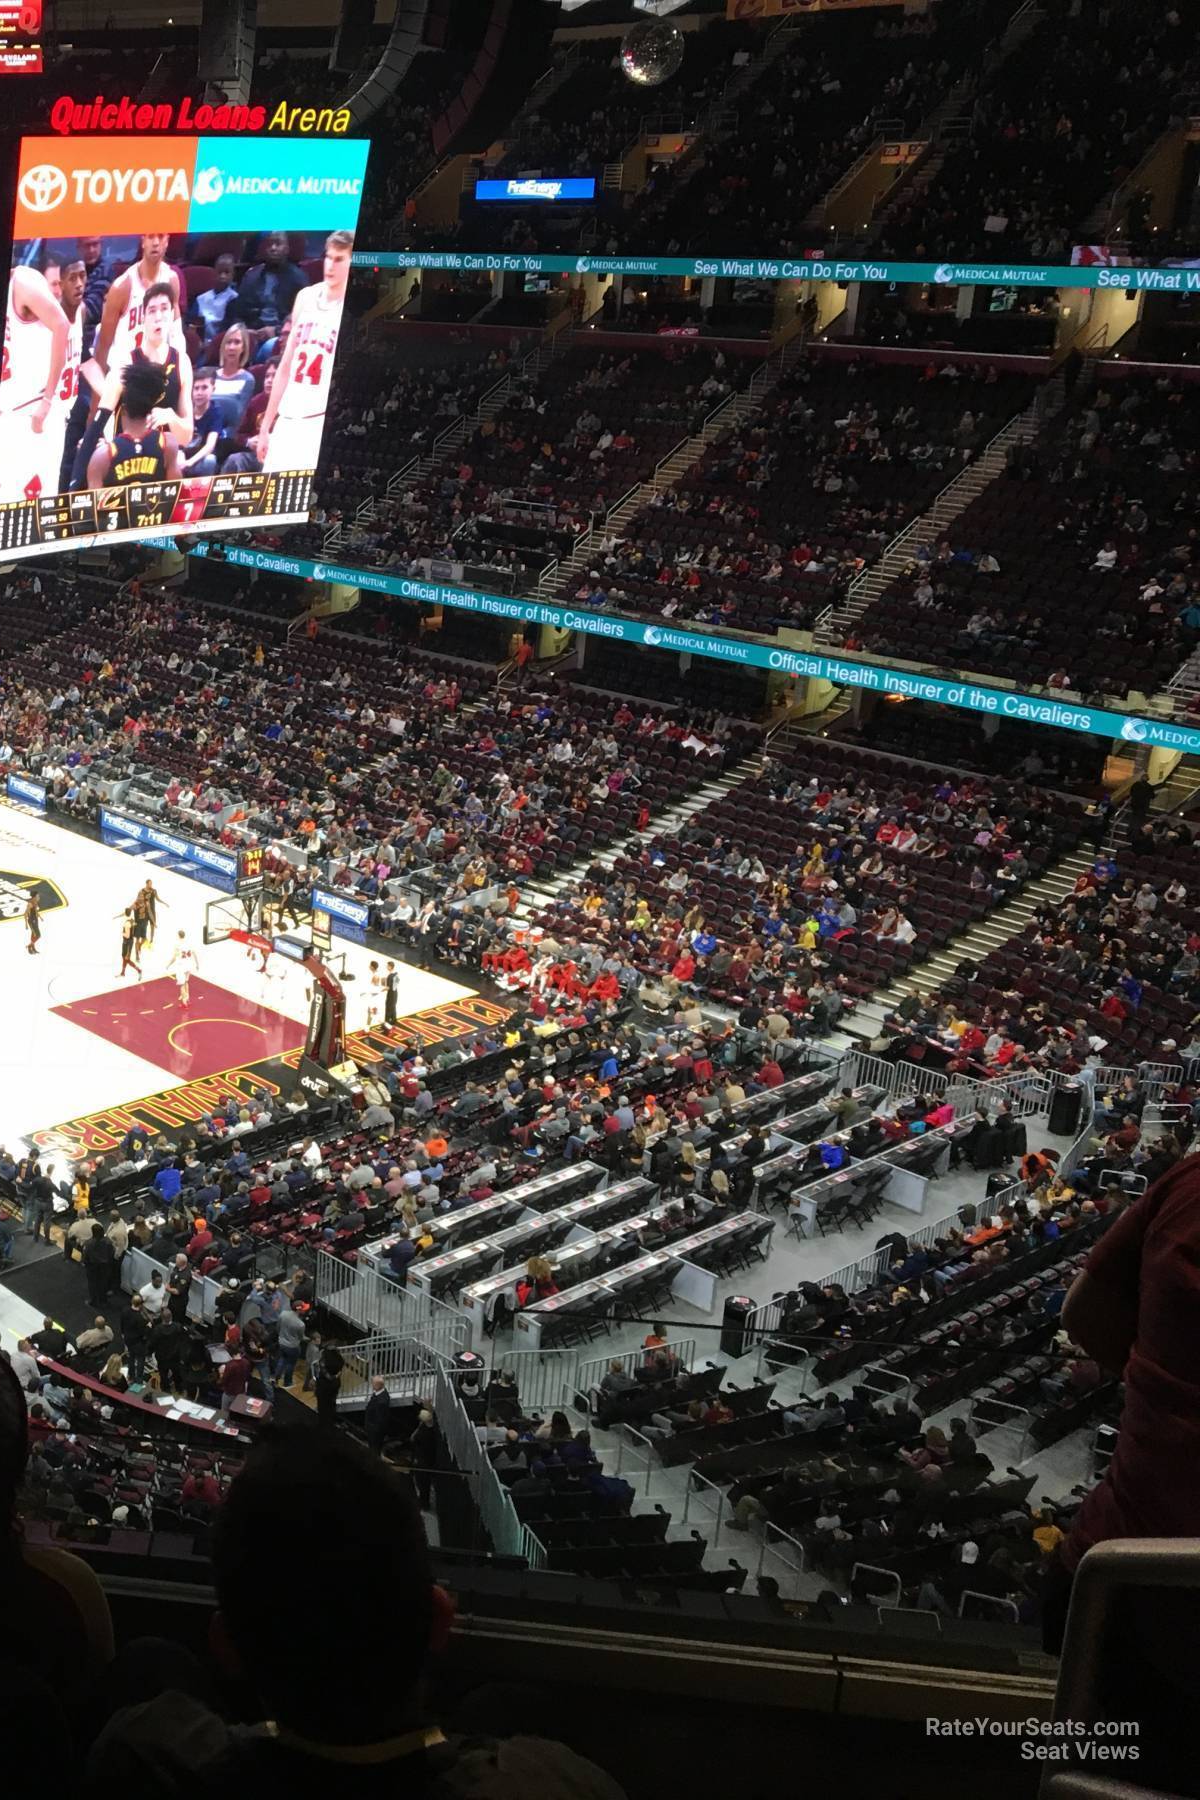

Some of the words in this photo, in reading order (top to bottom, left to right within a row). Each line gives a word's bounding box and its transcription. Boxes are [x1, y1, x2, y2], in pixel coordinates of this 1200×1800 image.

[51, 96, 171, 135] Quicken
[177, 98, 266, 131] Loans
[268, 101, 351, 132] Arena
[72, 169, 189, 204] TOYOTA
[225, 177, 293, 195] MEDICAL
[297, 177, 361, 195] MUTUAL
[507, 179, 562, 196] FirstEnergy
[352, 255, 379, 264] UTUAL
[399, 254, 417, 267] See
[418, 254, 443, 267] What
[445, 255, 460, 267] We
[463, 256, 484, 268] Can
[486, 256, 501, 269] Do
[504, 257, 520, 269] For
[522, 257, 542, 270] You
[591, 261, 623, 270] MEDICAL
[626, 261, 657, 270] MUTUAL
[694, 260, 719, 274] See
[722, 261, 754, 275] What
[758, 262, 779, 276] We
[782, 262, 808, 277] Can
[812, 263, 831, 277] Do
[835, 264, 859, 279] For
[862, 265, 887, 279] You
[955, 269, 1000, 280] MEDICAL
[1002, 270, 1047, 281] MUTUAL
[1097, 270, 1130, 286] See
[1136, 271, 1180, 288] What
[1186, 273, 1200, 289] W
[293, 351, 323, 386] 24
[114, 456, 158, 479] SEXTON
[107, 512, 118, 530] 3
[137, 513, 162, 526] 7:11
[184, 503, 194, 522] 7
[229, 550, 239, 563] of
[240, 551, 255, 565] the
[257, 553, 299, 574] Cavaliers
[327, 569, 359, 584] MEDICAL
[360, 575, 387, 588] MUTUAL
[401, 582, 439, 601] Official
[442, 589, 478, 608] Health
[481, 596, 522, 616] Insurer
[526, 605, 539, 620] of
[541, 608, 560, 624] the
[563, 612, 624, 637] Cavaliers
[663, 633, 705, 649] MEDICAL
[707, 639, 748, 658] MUTUAL
[769, 651, 822, 675] Official
[826, 662, 878, 687] Health
[884, 673, 941, 699] Insurer
[948, 687, 965, 703] of
[970, 690, 997, 710] the
[1003, 696, 1091, 729] Cavaliers
[1149, 727, 1200, 747] MEDIC
[32, 1071, 280, 1160] CAVALIERS
